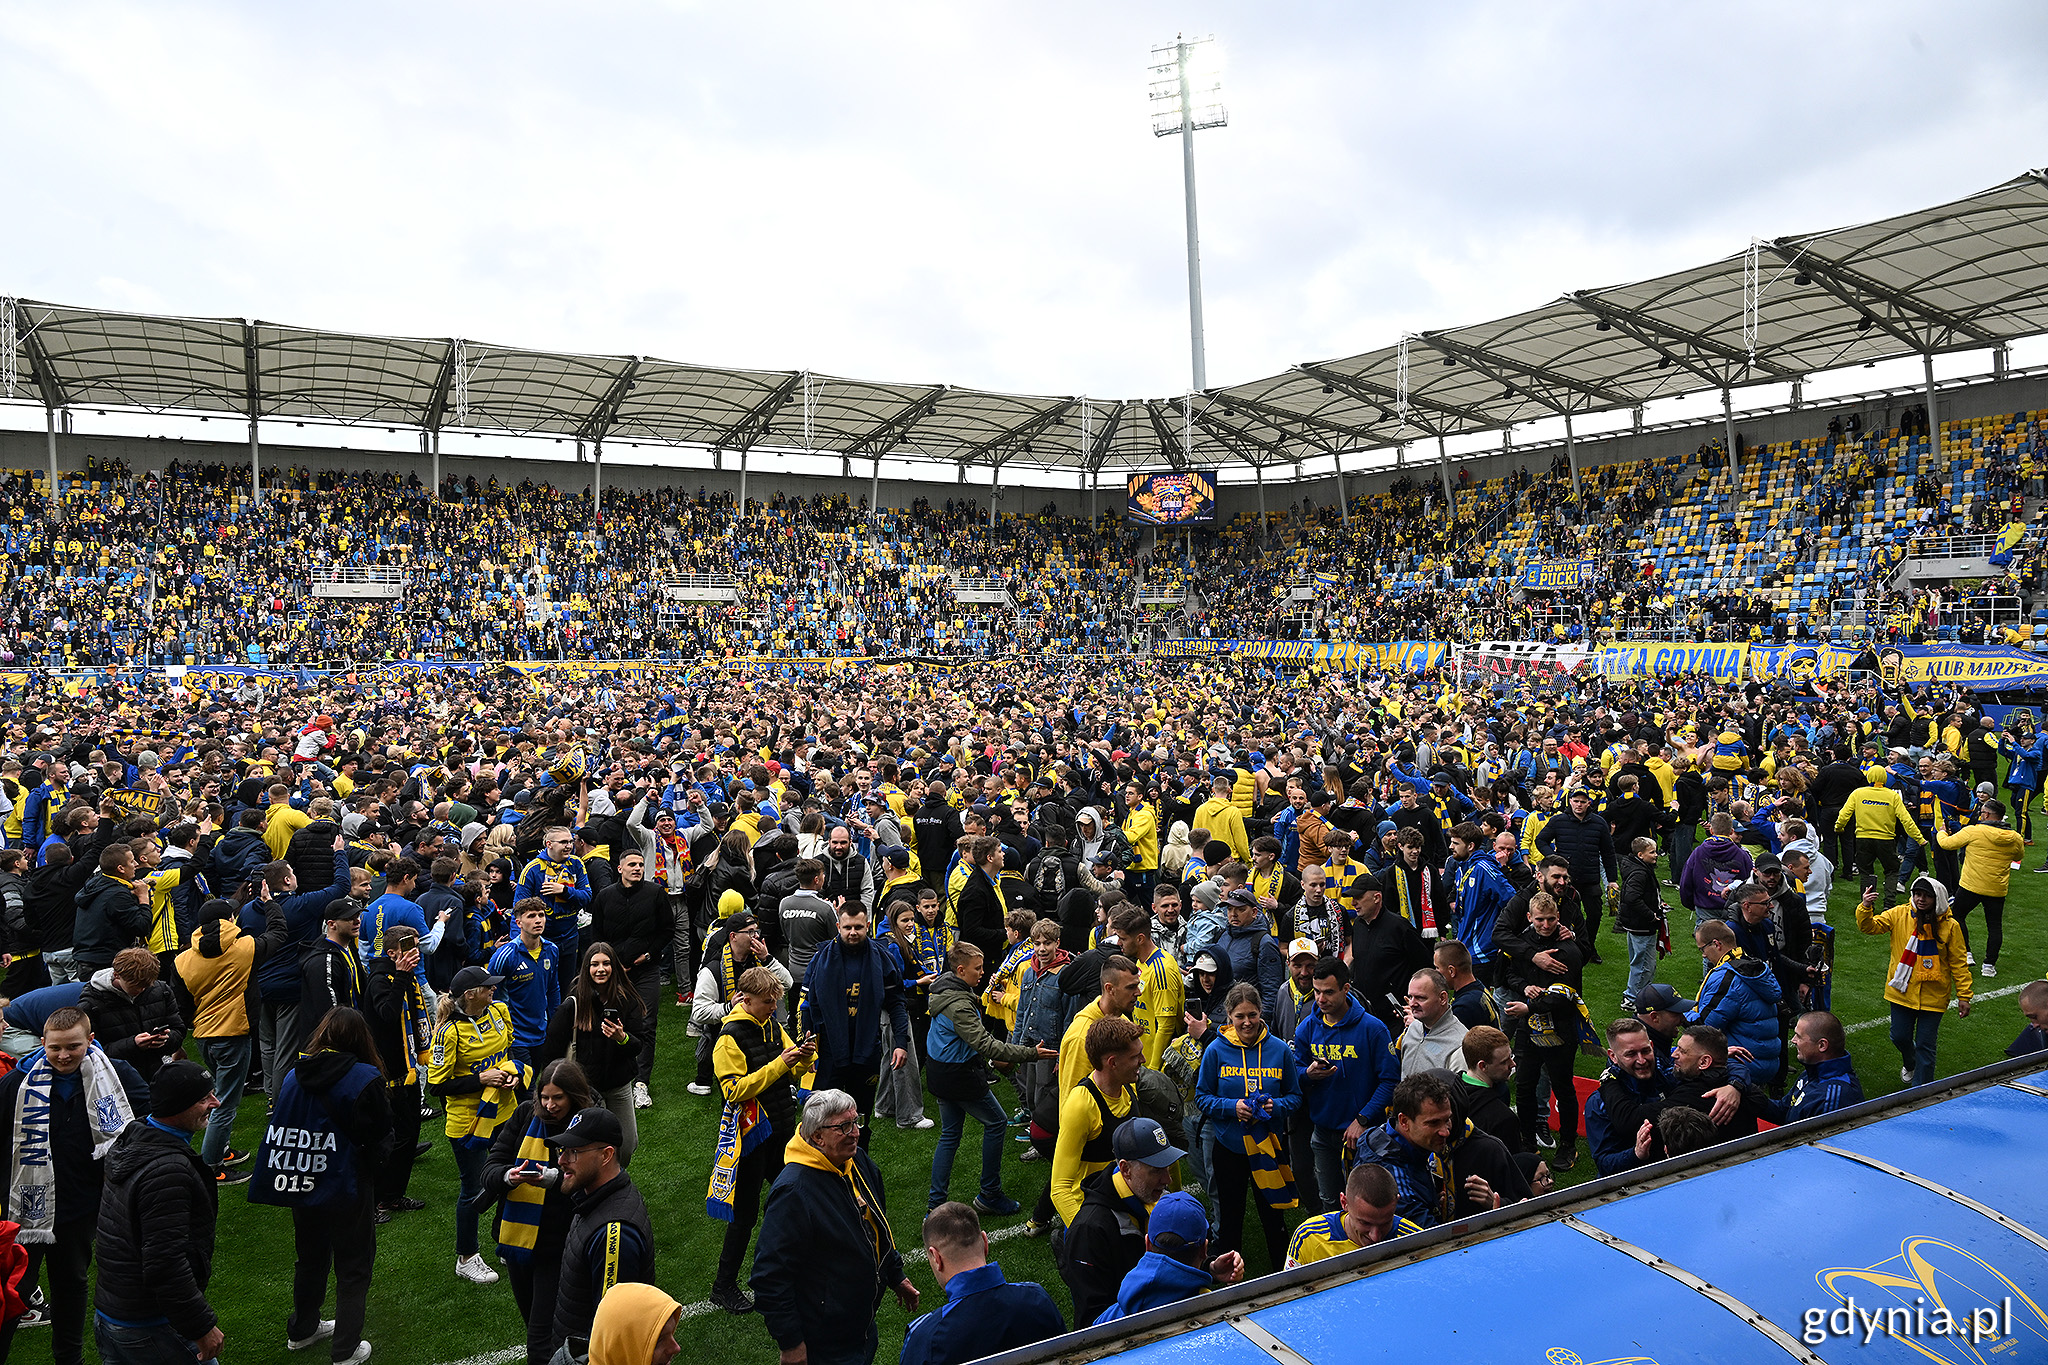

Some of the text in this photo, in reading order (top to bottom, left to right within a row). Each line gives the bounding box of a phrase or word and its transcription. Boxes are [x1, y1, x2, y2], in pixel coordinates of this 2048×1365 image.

[1541, 563, 1580, 572] POWIAT
[1539, 570, 1580, 585] PUCKI
[382, 585, 394, 594] 16
[1313, 641, 1446, 677] ARKOWCY
[1591, 647, 1741, 678] ARKA GDYNIA
[1925, 661, 1964, 677] KLUB
[1269, 870, 1281, 896] ARKA
[782, 909, 817, 920] GDYNIA
[1310, 1043, 1358, 1059] ARKA
[1219, 1066, 1283, 1080] ARKA GDYNIA
[19, 1060, 53, 1167] OZNAŃ
[265, 1124, 337, 1152] MEDIA
[267, 1148, 328, 1173] KLUB
[274, 1173, 315, 1192] 015
